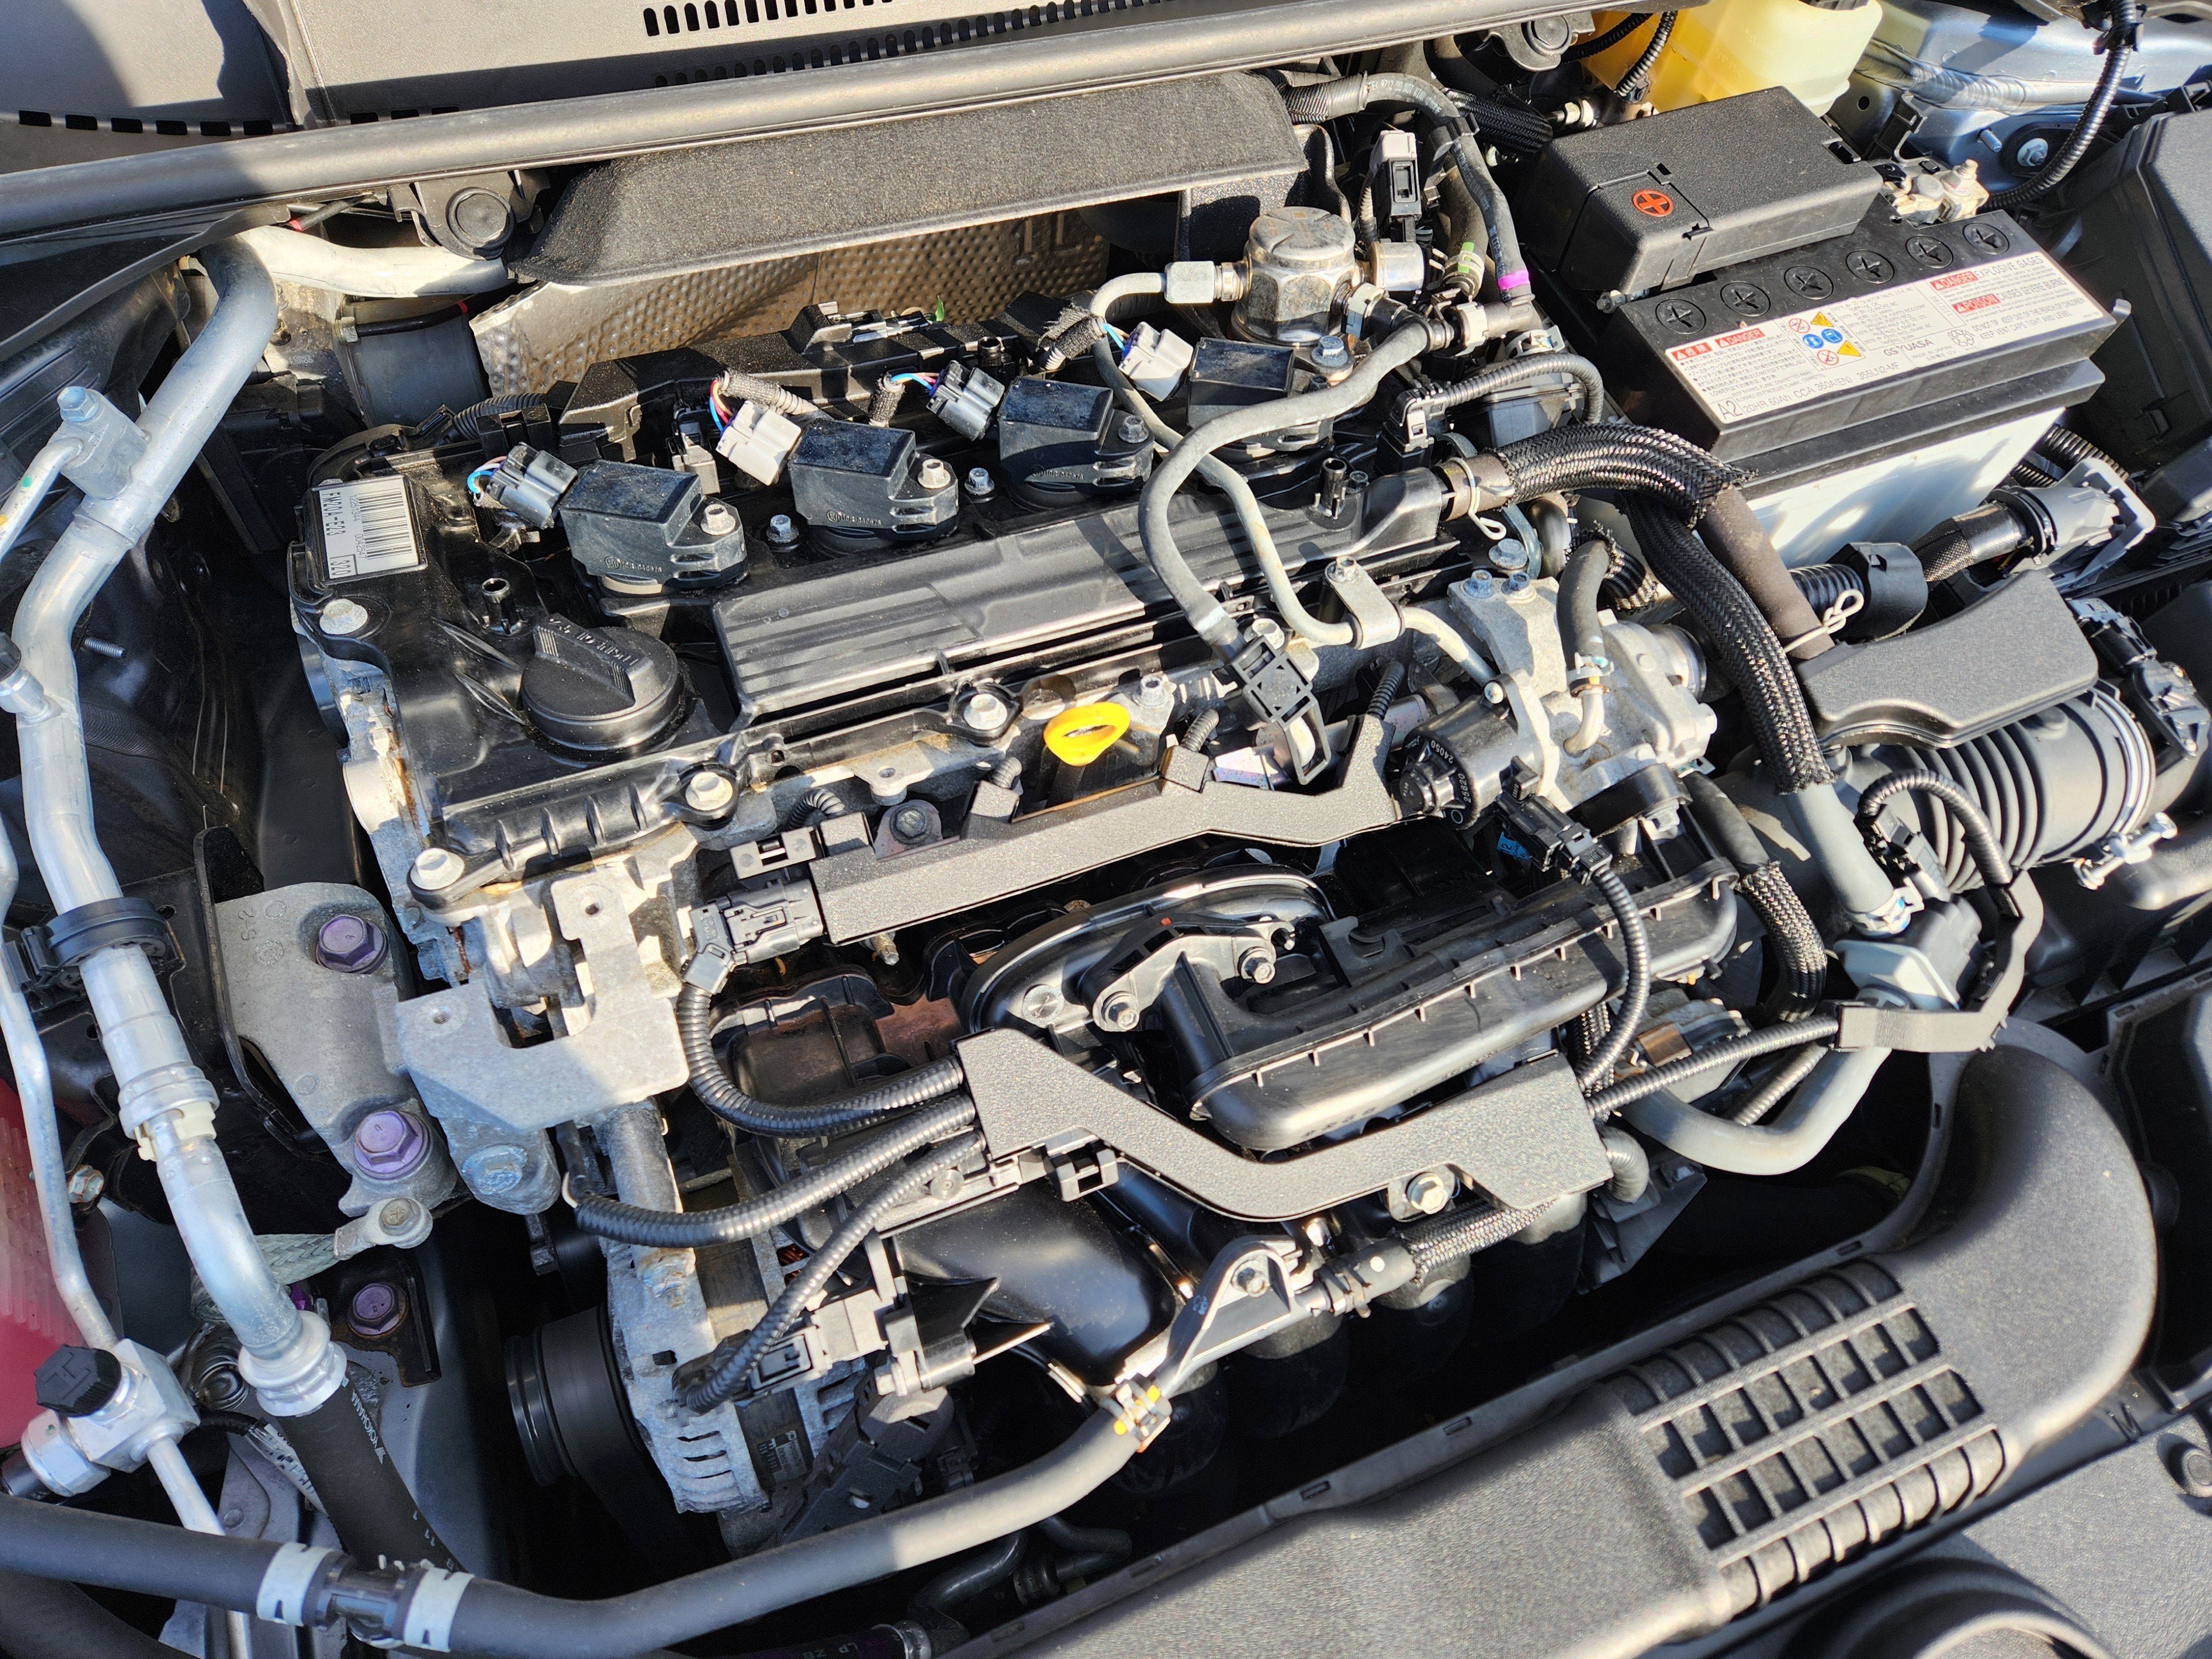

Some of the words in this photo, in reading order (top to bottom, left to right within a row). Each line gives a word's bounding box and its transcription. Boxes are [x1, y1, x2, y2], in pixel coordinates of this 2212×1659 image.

[1940, 273, 1976, 287] DANGER
[1974, 262, 2017, 278] EXPLOSIVE
[2016, 255, 2044, 268] GASES
[1962, 295, 1998, 309] POISON
[1996, 289, 2023, 301] CAUSES
[2020, 283, 2046, 295] SEVERE
[2042, 277, 2067, 289] BURNS
[2038, 305, 2056, 313] REACH
[1726, 330, 1764, 345] DANGER
[1979, 330, 1994, 339] KEEP
[1994, 326, 2010, 335] VENT
[2009, 321, 2027, 331] CAPS
[2024, 317, 2041, 326] TIGHT
[1883, 347, 1898, 356] GS
[1896, 338, 1934, 351] YUASA
[1743, 400, 1768, 413] 20HR
[1767, 394, 1792, 405] 60Ah
[1793, 387, 1815, 398] CCA
[1814, 376, 1853, 390] 360A(EN)
[1856, 362, 1898, 380] 355LN2-MF
[1717, 400, 1743, 419] A2
[322, 492, 346, 536] FM20A-E23
[349, 495, 361, 521] 12251344
[355, 534, 367, 559] 0042547
[330, 560, 352, 576] 320
[1431, 740, 1454, 764] 24050
[1458, 773, 1472, 803] 25620
[351, 1389, 378, 1448] YOKOHAMA
